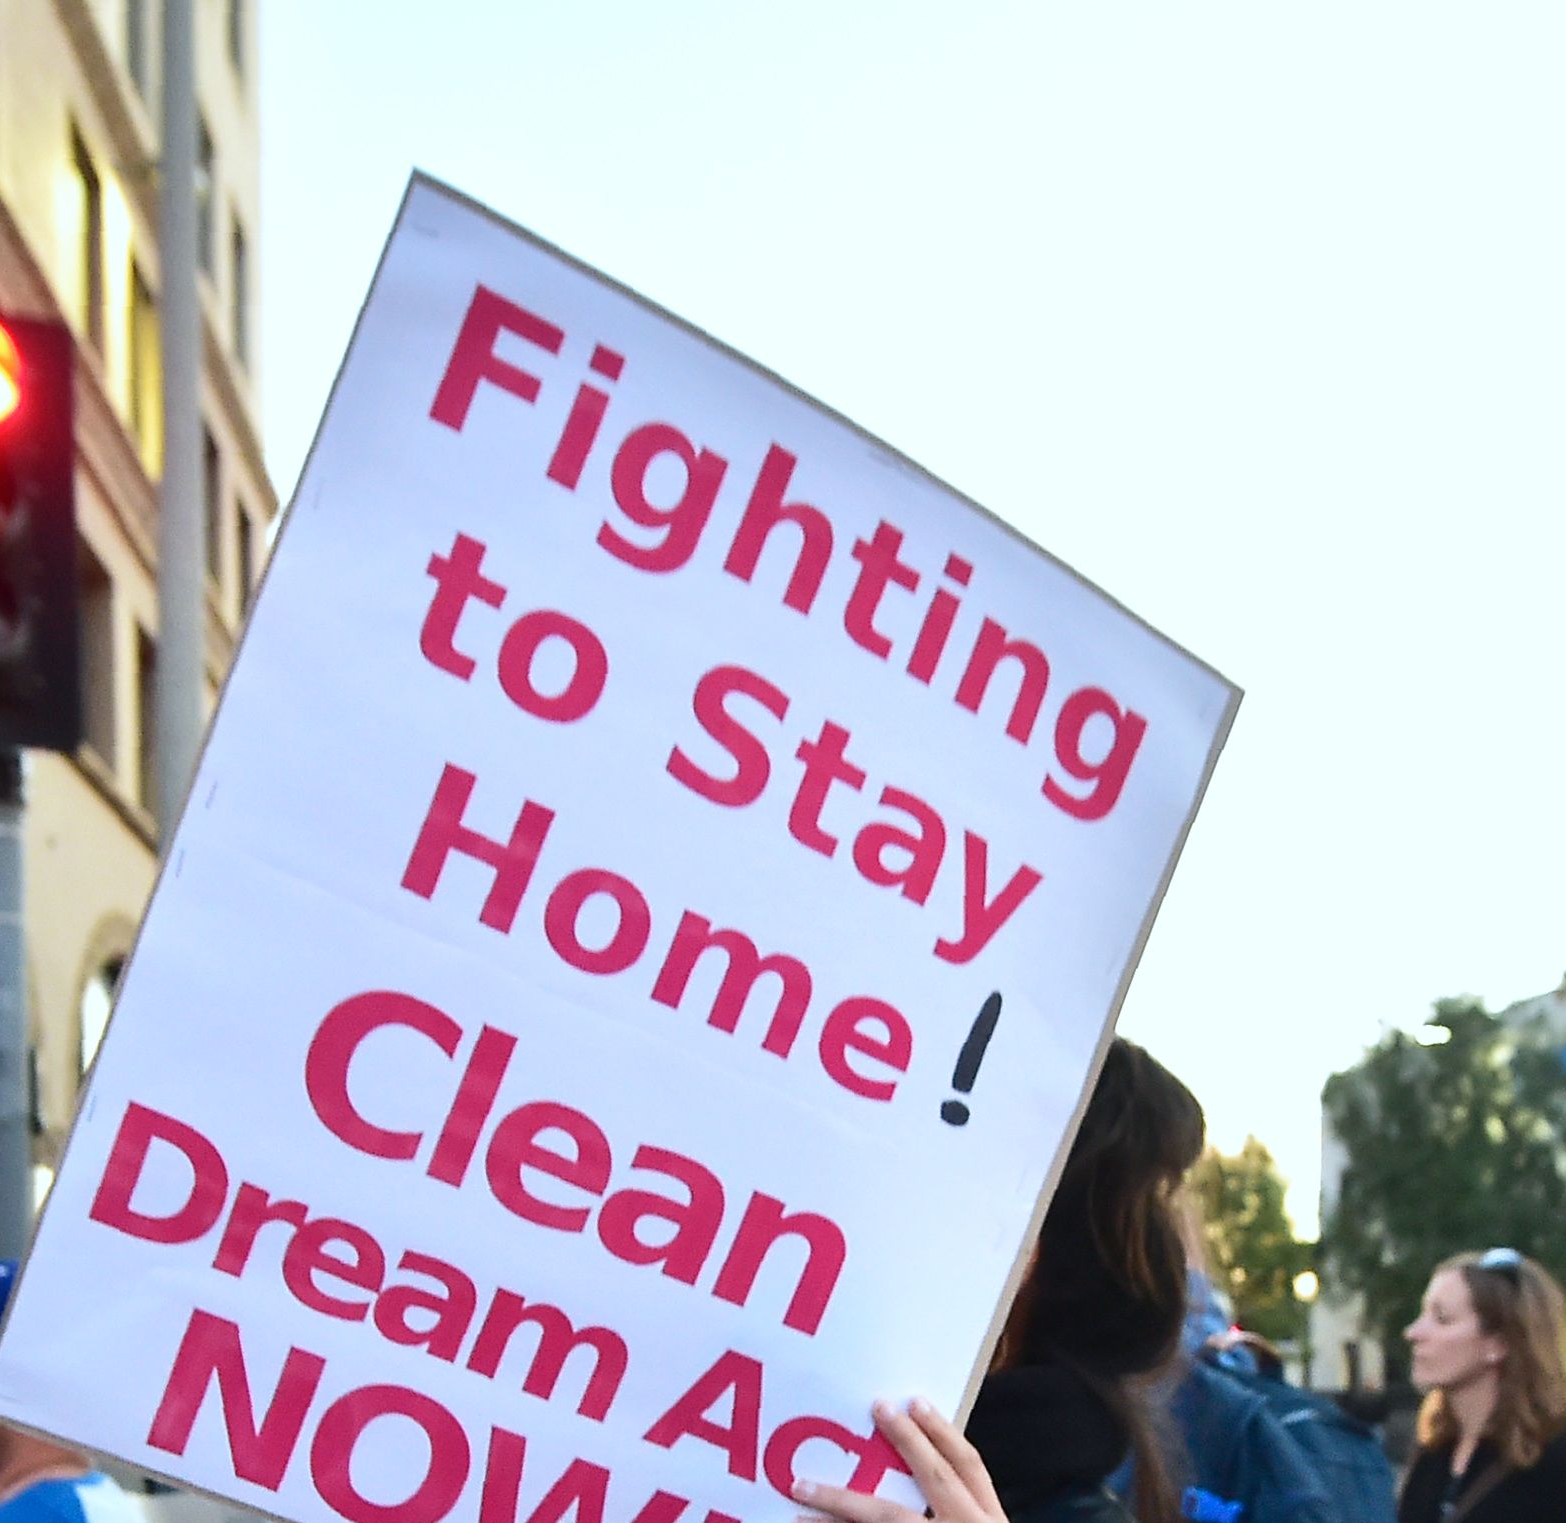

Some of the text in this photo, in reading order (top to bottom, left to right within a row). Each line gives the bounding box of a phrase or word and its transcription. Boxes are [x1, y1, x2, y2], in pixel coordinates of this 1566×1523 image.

[419, 533, 1043, 966] to Stay
[429, 286, 1148, 822] Fighting
[401, 763, 1005, 1129] Home!
[89, 1102, 915, 1507] Dream Act
[304, 989, 848, 1337] Clean
